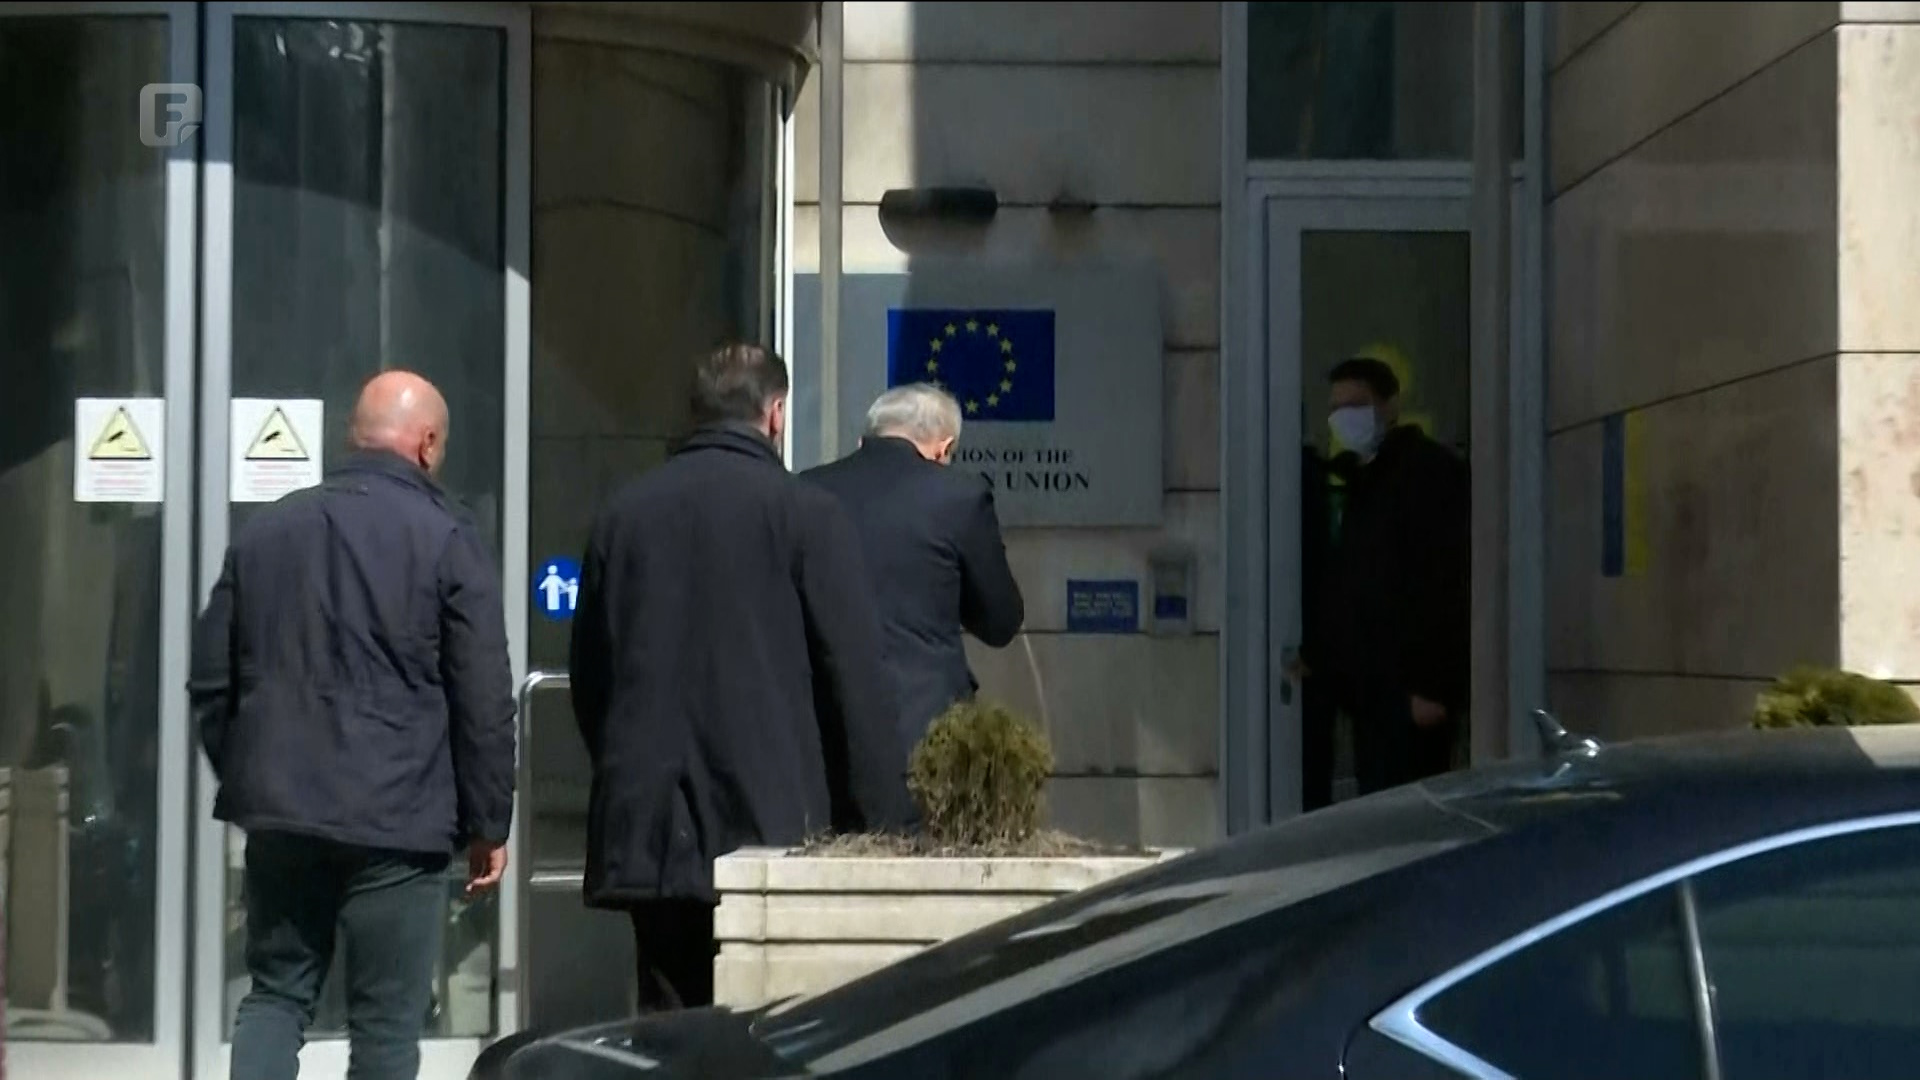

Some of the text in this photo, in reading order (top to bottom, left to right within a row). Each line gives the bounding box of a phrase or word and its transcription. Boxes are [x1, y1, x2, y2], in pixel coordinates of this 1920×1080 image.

[1003, 449, 1025, 463] OF
[1035, 449, 1073, 463] THE
[1005, 471, 1090, 491] UNION
